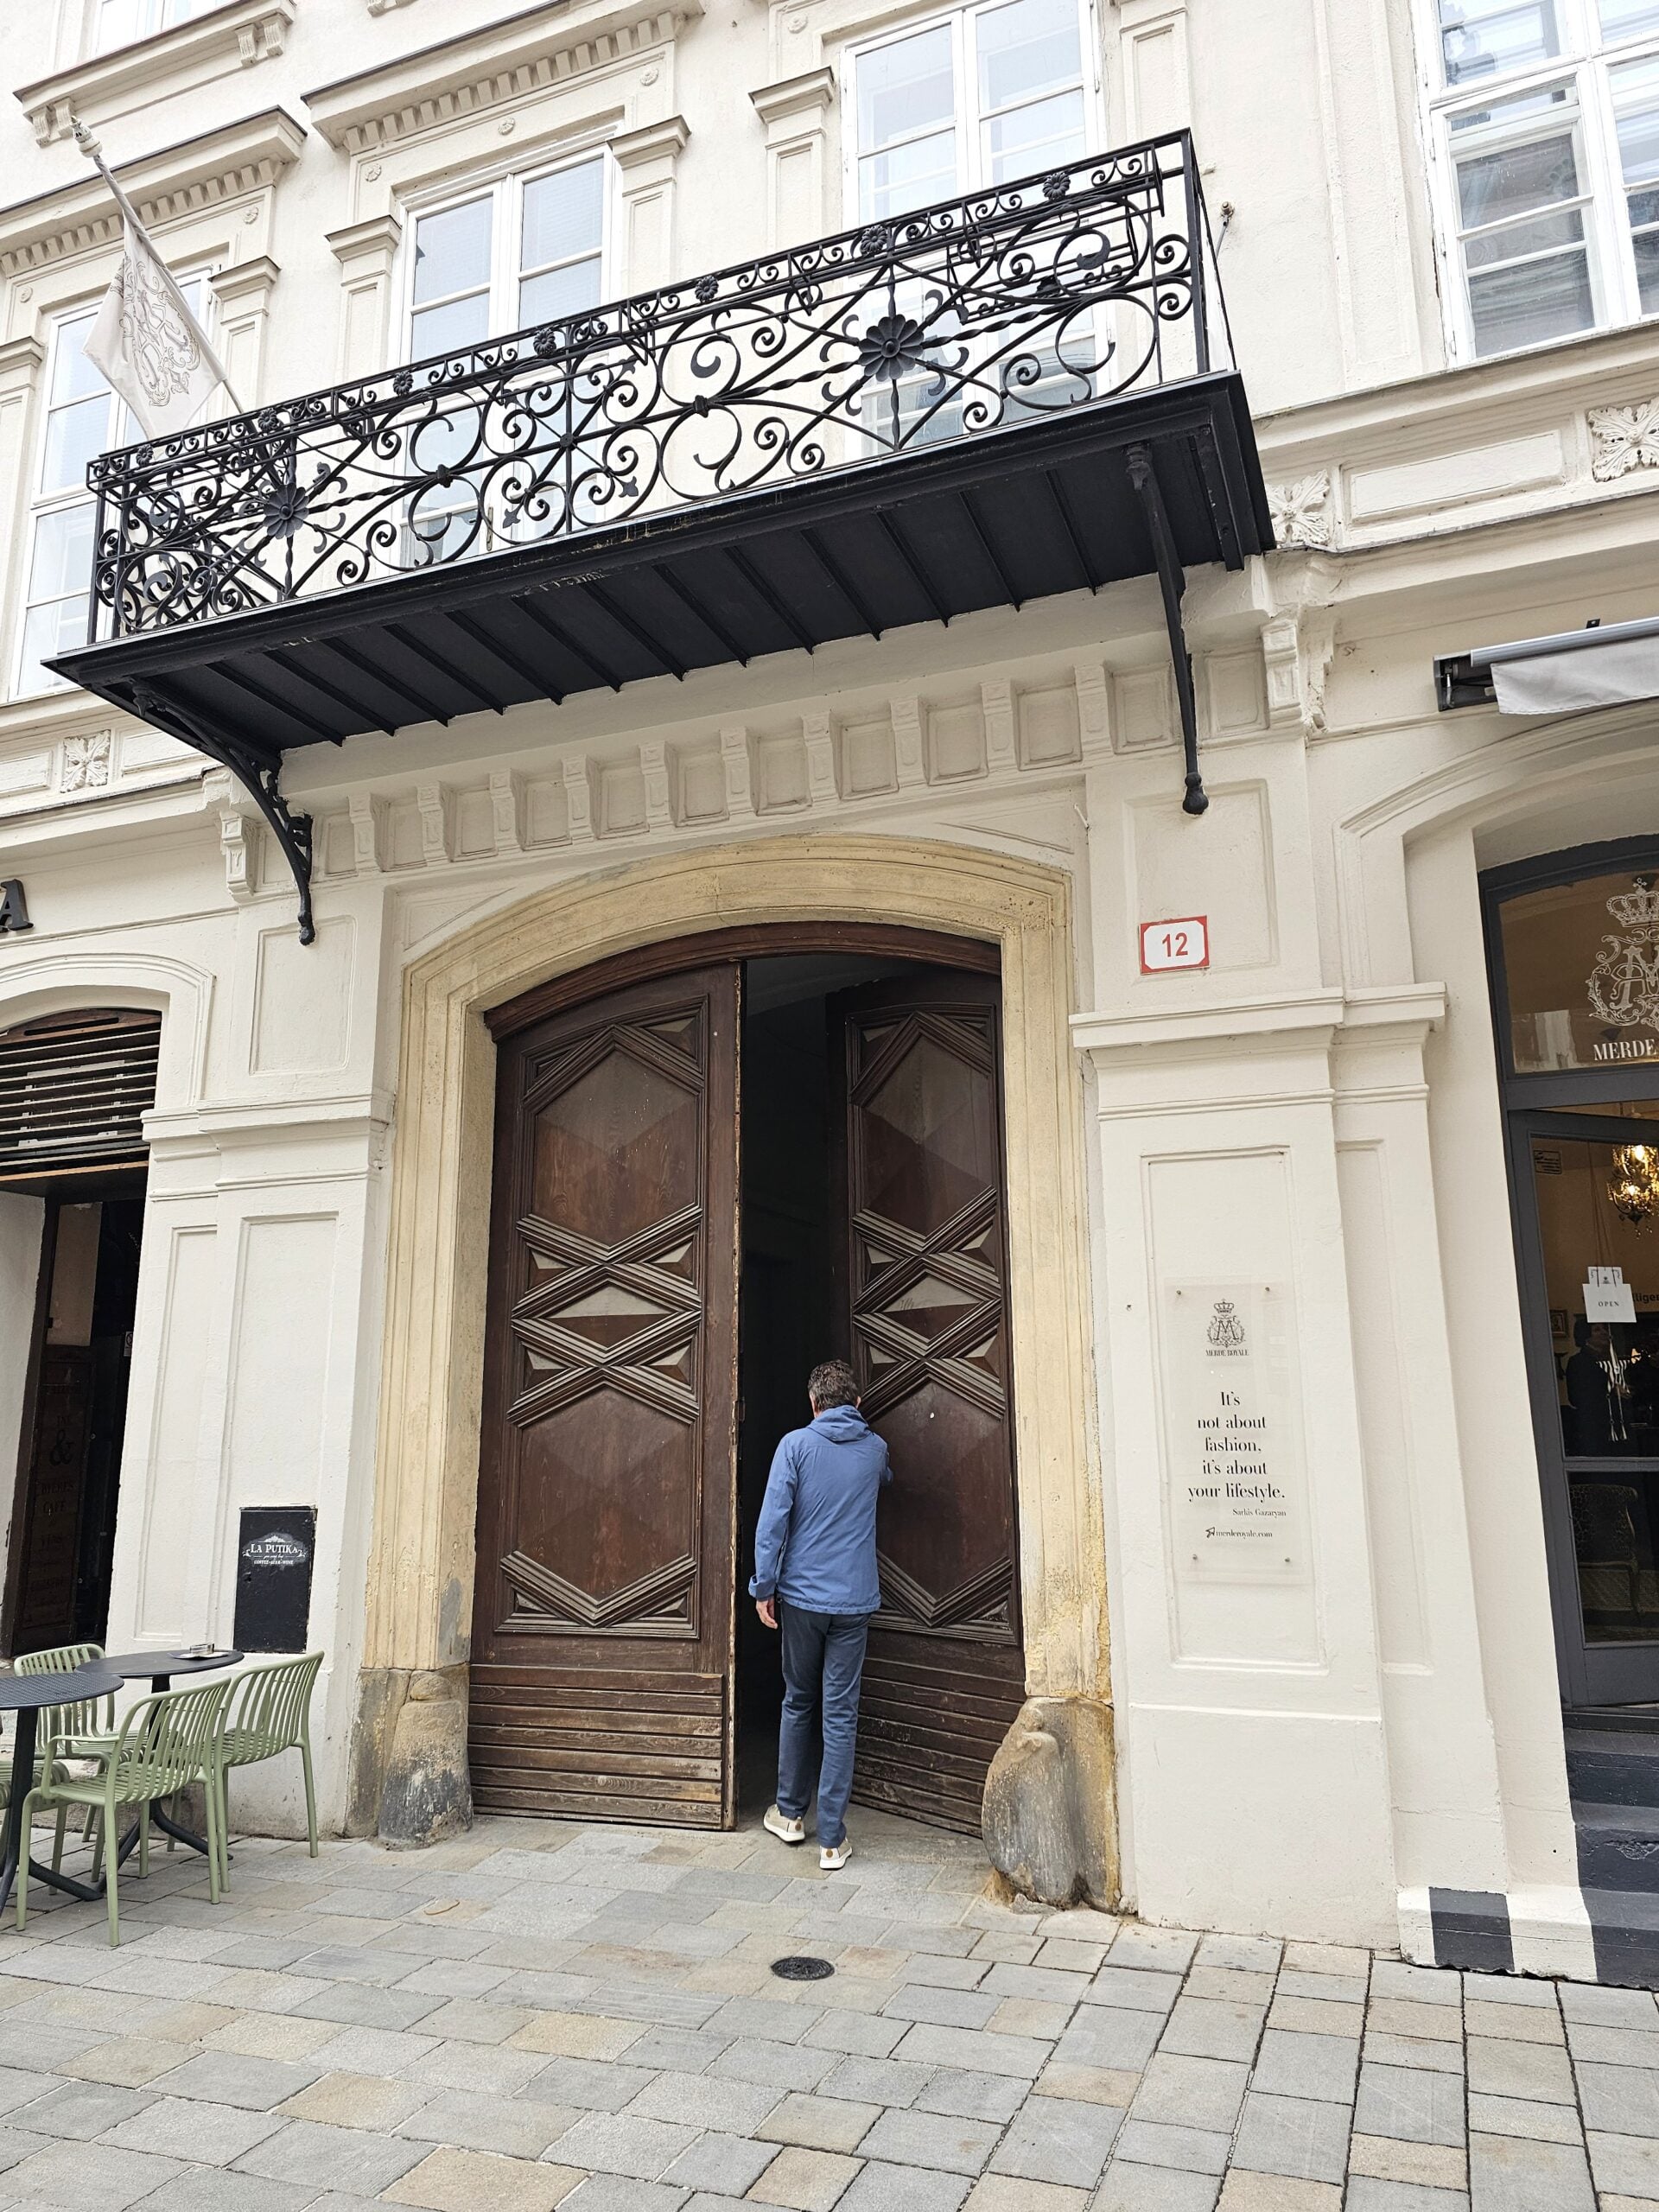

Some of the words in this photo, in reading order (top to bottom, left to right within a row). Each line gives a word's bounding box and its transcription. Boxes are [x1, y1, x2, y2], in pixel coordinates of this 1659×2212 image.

[1161, 932, 1188, 957] 12
[1592, 1039, 1657, 1061] MERDE
[1221, 1391, 1241, 1406] It's
[1198, 1416, 1220, 1429] not
[1225, 1414, 1267, 1429] about
[1203, 1459, 1222, 1474] it's
[1226, 1459, 1268, 1475] about
[1188, 1486, 1221, 1503] your
[1225, 1482, 1286, 1503] lifestyle.
[1232, 1508, 1254, 1516] Sarkis
[1255, 1508, 1287, 1518] Gazaryan
[251, 1543, 263, 1554] LA
[265, 1543, 299, 1554] PUTIKA
